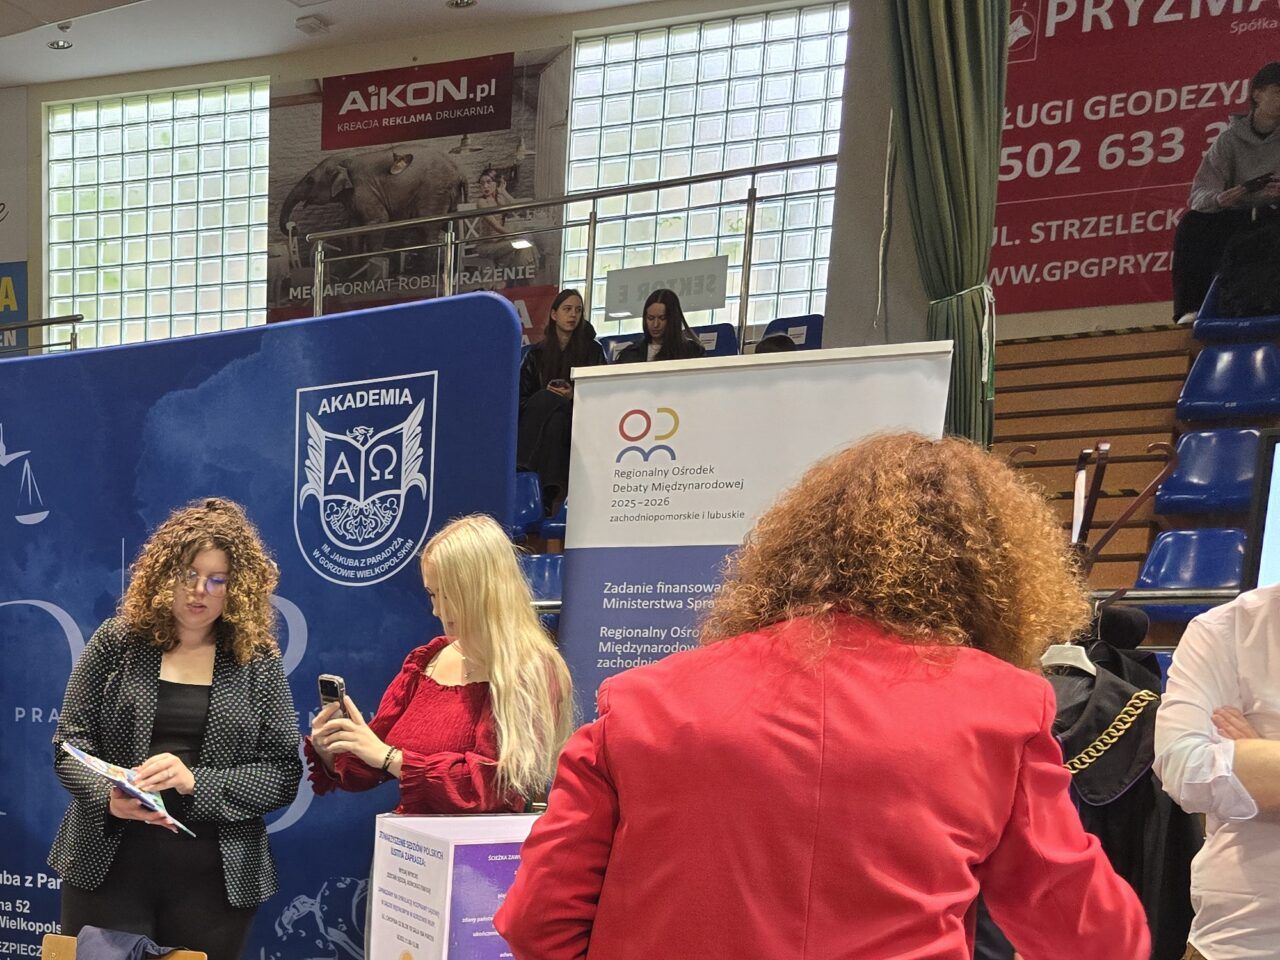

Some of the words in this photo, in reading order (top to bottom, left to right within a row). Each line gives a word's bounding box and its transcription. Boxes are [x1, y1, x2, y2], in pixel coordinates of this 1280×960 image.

[337, 118, 380, 132] KREACJA
[382, 112, 433, 127] REKLAMA
[435, 105, 495, 121] DRUKARNIA
[997, 137, 1082, 182] 502
[1097, 126, 1186, 171] 633
[289, 277, 399, 300] MEAFORMAT
[399, 274, 438, 291] ROBI
[317, 387, 414, 416] AKADEMIA
[614, 466, 670, 480] Regionalny
[671, 464, 715, 476] Ośrodek
[612, 483, 649, 493] Debaty
[651, 478, 745, 494] Międzynarodowej
[609, 511, 700, 523] zachodniopomorskie
[706, 509, 746, 520] lubuskie
[312, 549, 320, 560] W
[318, 556, 356, 579] GORZOWIE
[356, 538, 415, 579] WIELKOPOLSKIM
[321, 543, 331, 559] IM.
[328, 551, 360, 568] JAKUBA
[366, 536, 405, 567] PARADYŻA
[603, 581, 654, 594] Zadanie
[602, 597, 684, 609] Ministerstwa
[599, 626, 668, 640] Regionalny
[24, 875, 34, 888] z
[15, 899, 31, 914] 52
